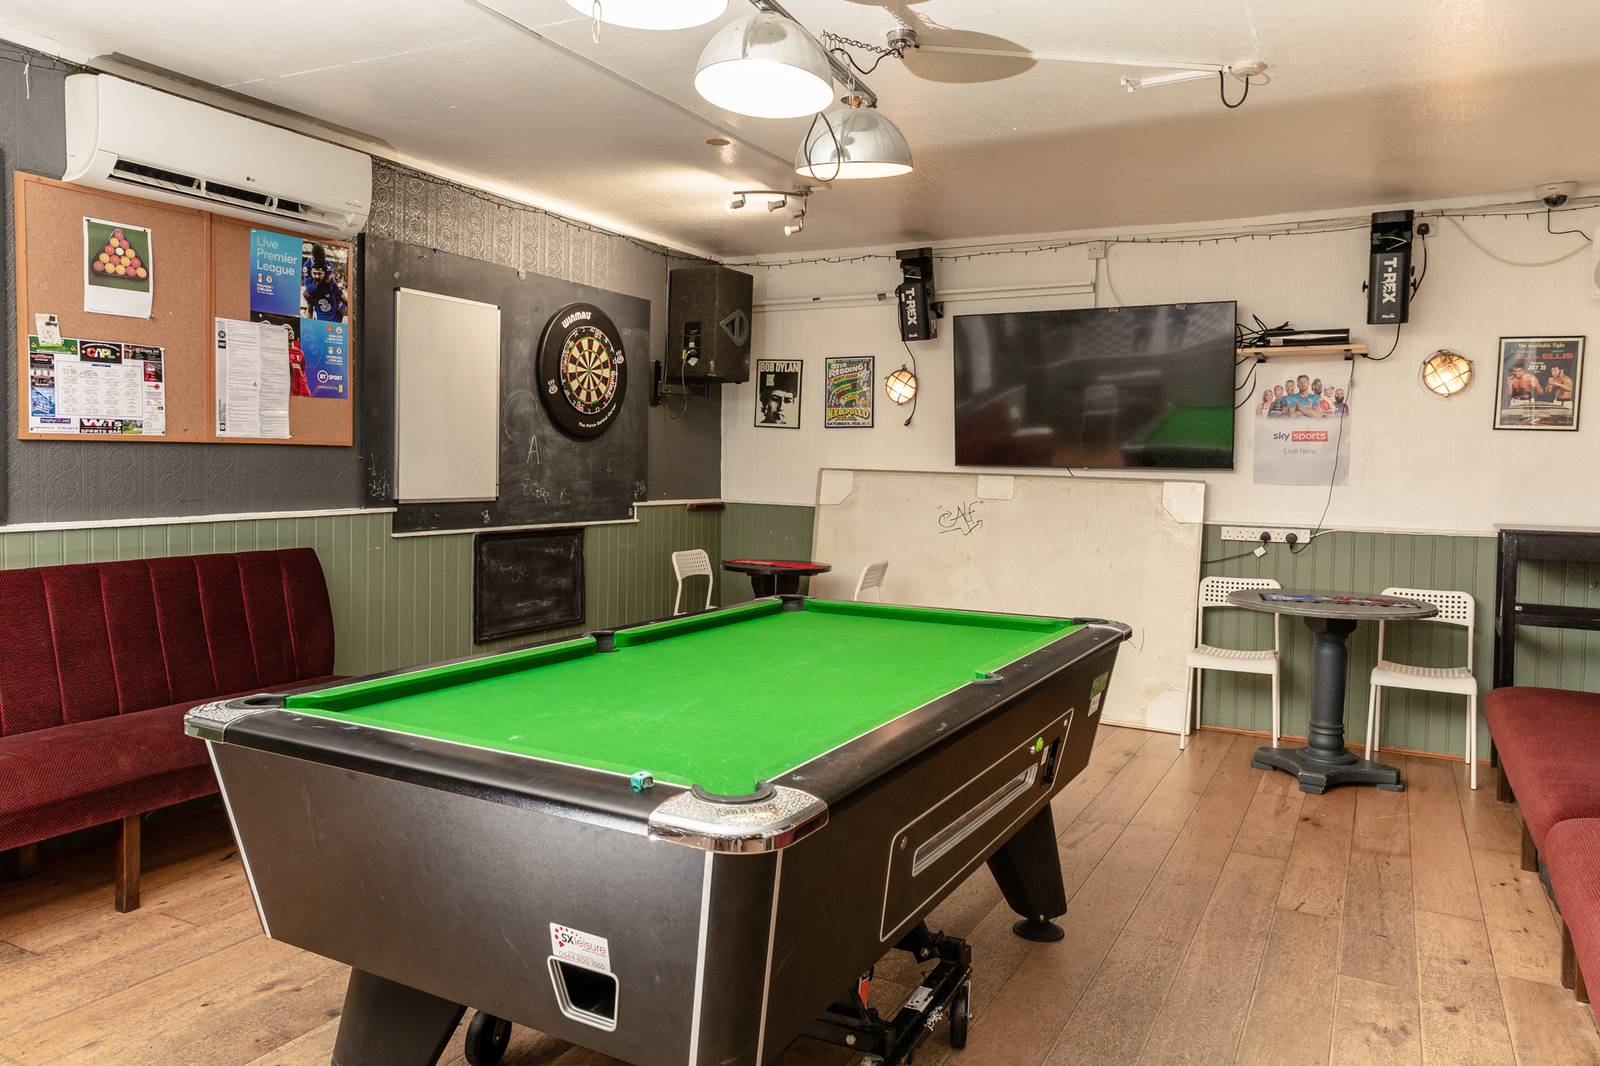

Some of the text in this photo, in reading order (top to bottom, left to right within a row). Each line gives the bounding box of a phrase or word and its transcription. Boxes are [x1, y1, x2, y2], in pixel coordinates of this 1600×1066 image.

[256, 235, 279, 249] Live
[256, 247, 298, 265] Premier
[256, 259, 296, 276] League
[1381, 257, 1398, 304] T-REX
[905, 287, 918, 326] T-REX
[561, 311, 592, 328] WINMAU
[760, 362, 799, 373] BOB DYLAN
[828, 364, 864, 378] REDDING
[831, 362, 847, 370] OTIS
[838, 408, 871, 420] APOLLO
[1272, 431, 1328, 441] sky sports
